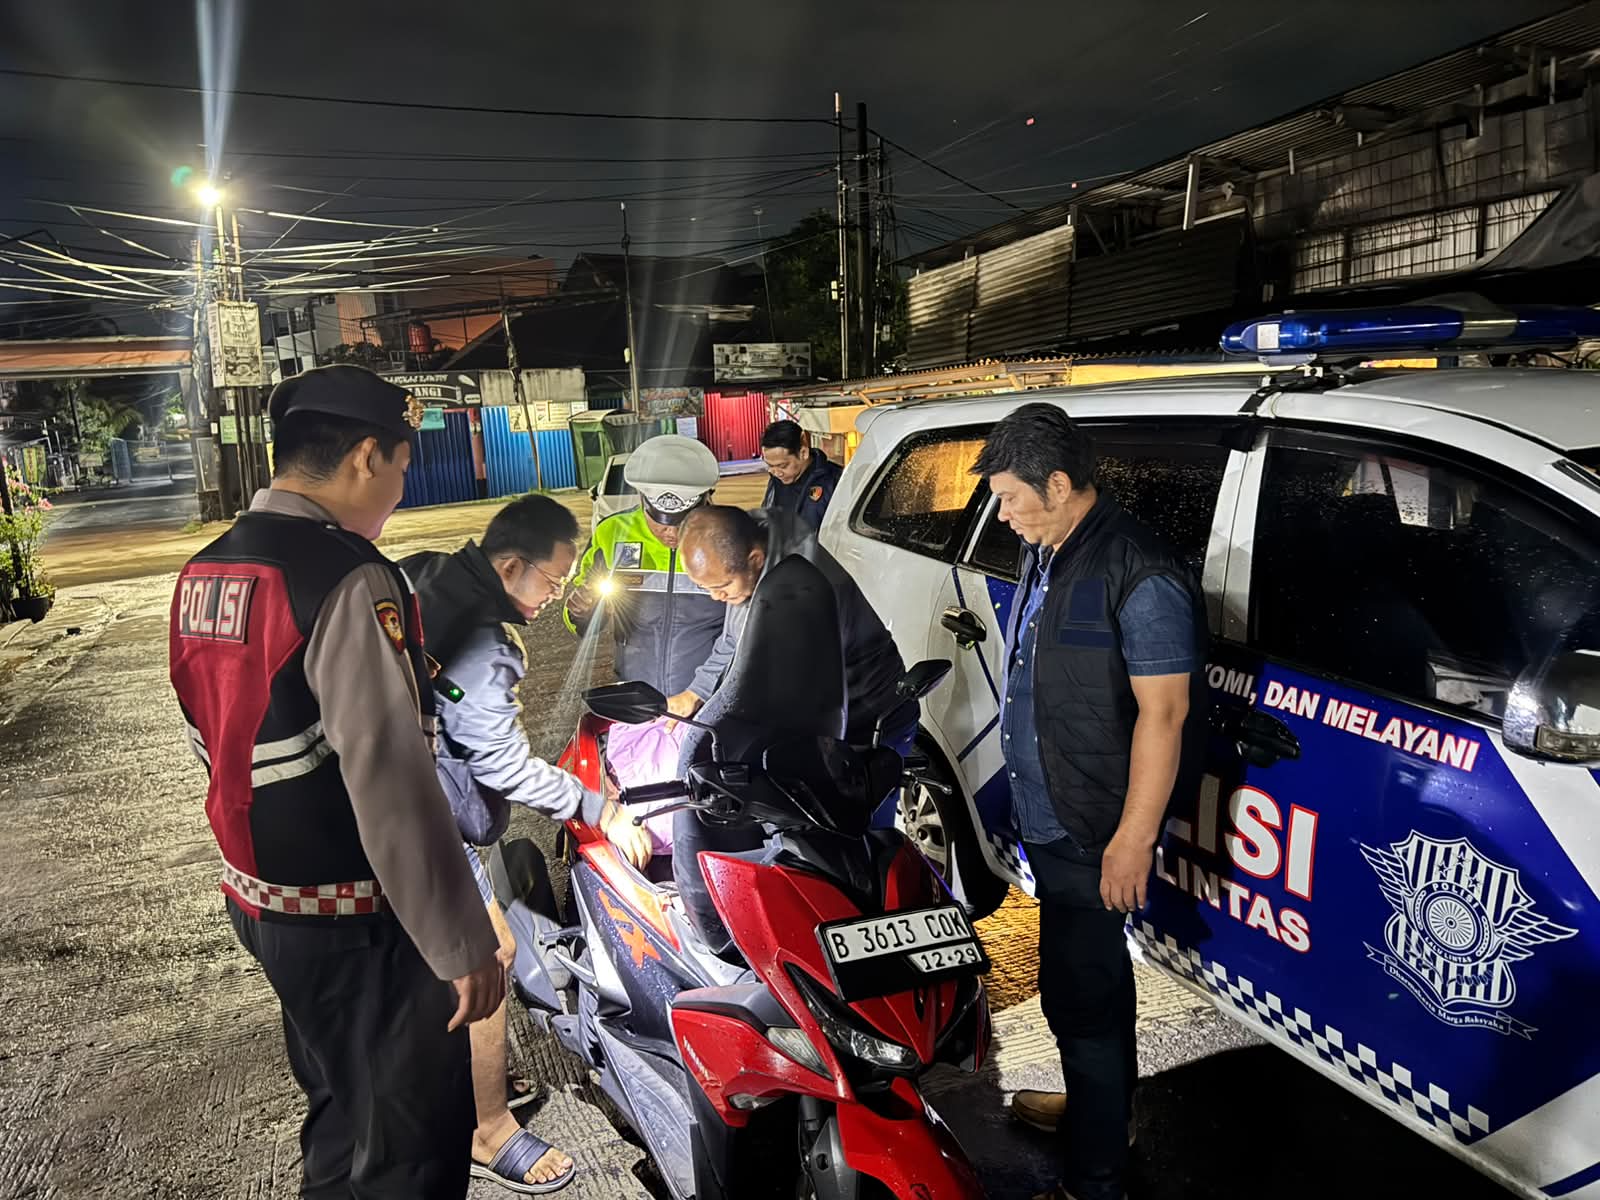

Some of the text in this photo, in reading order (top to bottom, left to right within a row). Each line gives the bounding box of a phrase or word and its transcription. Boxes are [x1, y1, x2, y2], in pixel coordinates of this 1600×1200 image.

[408, 387, 442, 397] ANGI
[179, 580, 249, 637] POLISI
[1205, 663, 1481, 773] OMI, DAN MELAYANI
[1156, 845, 1311, 954] LINTAS
[1432, 882, 1480, 909] POLISI
[831, 910, 969, 959] B 3613 COK
[1437, 1008, 1464, 1025] Marga
